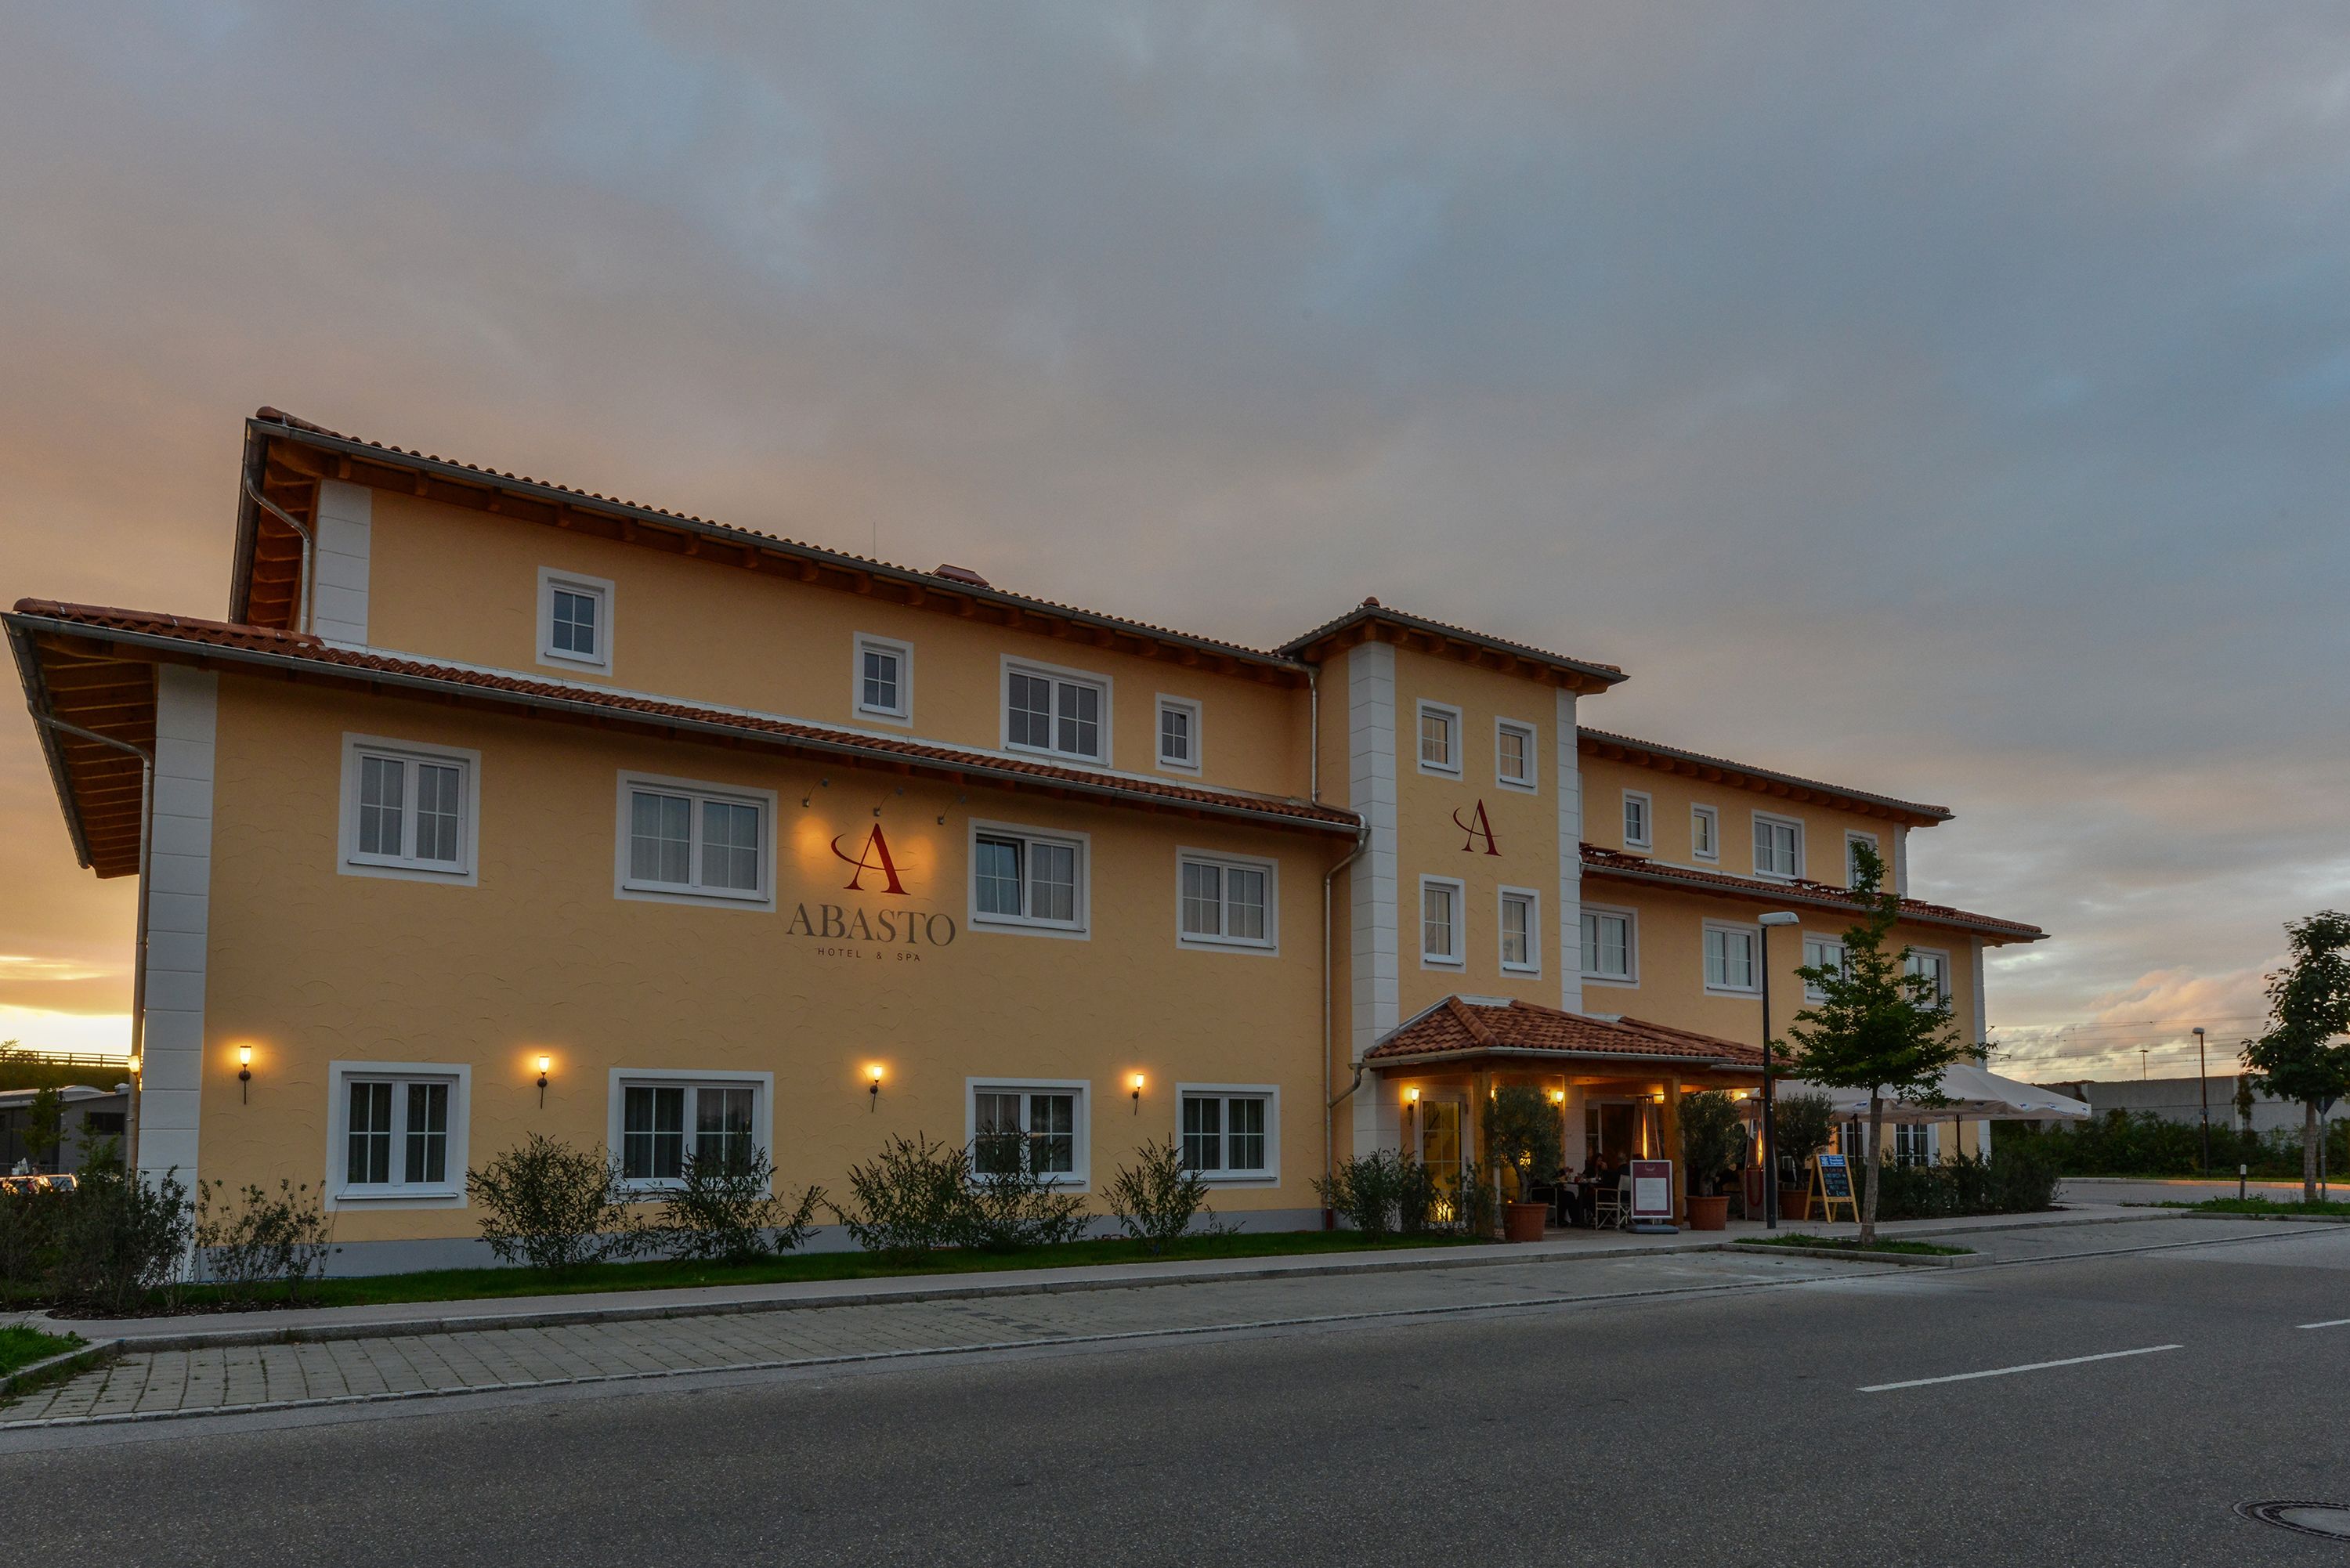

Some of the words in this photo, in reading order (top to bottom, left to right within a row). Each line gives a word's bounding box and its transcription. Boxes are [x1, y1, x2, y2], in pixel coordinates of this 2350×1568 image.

[1453, 798, 1502, 857] A
[830, 822, 913, 895] A
[786, 902, 956, 947] ABASTO
[817, 947, 862, 959] HOTEL
[876, 951, 883, 959] &
[896, 952, 921, 962] SPA
